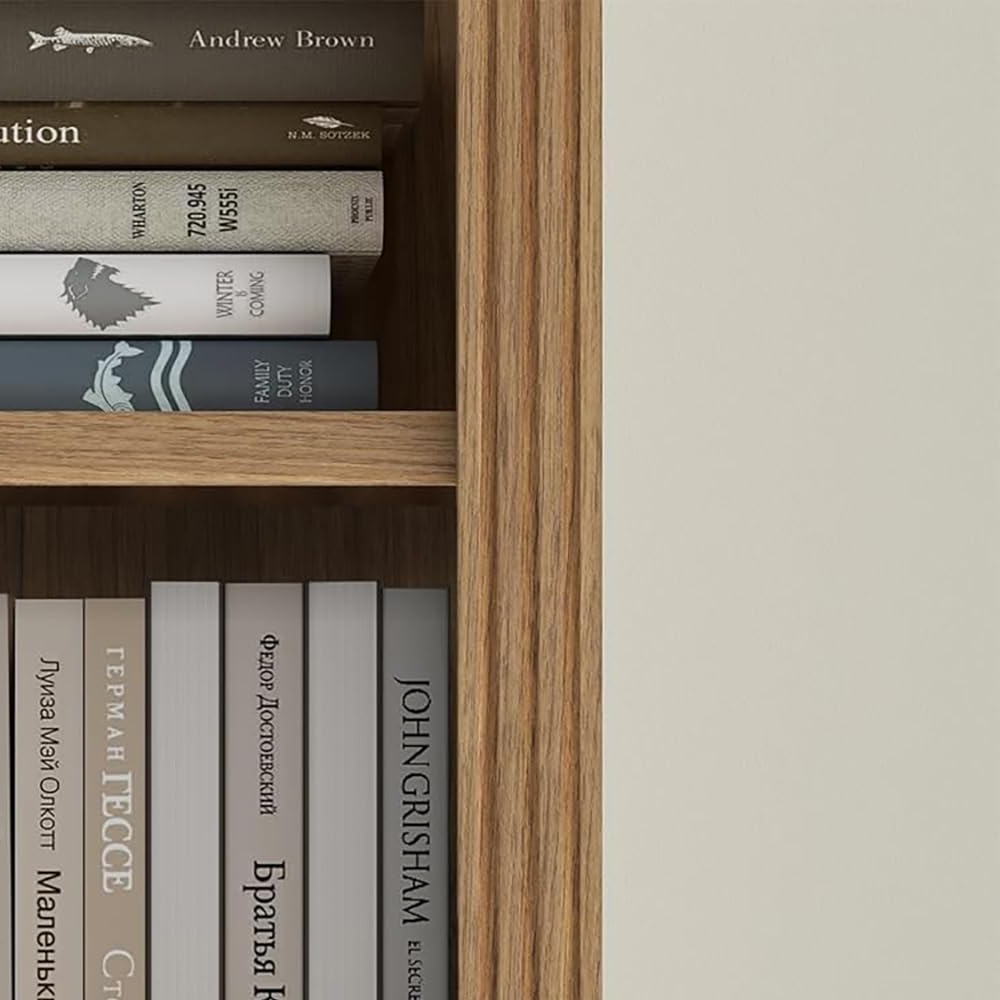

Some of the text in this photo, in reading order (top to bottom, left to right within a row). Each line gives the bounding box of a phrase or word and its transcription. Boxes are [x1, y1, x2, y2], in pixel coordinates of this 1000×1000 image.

[188, 29, 375, 50] Andrew Brown
[132, 181, 147, 240] WHARTON
[187, 183, 207, 238] 720.945
[218, 187, 239, 233] W555i
[215, 269, 234, 319] WINTER
[249, 271, 265, 318] COMING
[253, 359, 271, 404] FAMILY
[277, 364, 293, 398] DUTY
[299, 359, 313, 404] HONOR
[36, 657, 61, 850] Луиза Мэй Олкотт
[101, 646, 133, 894] ГЕРМАН ГЕССЕ
[393, 676, 432, 925] JOHN GRISHAM
[242, 860, 286, 976] Братья
[407, 940, 422, 955] EL
